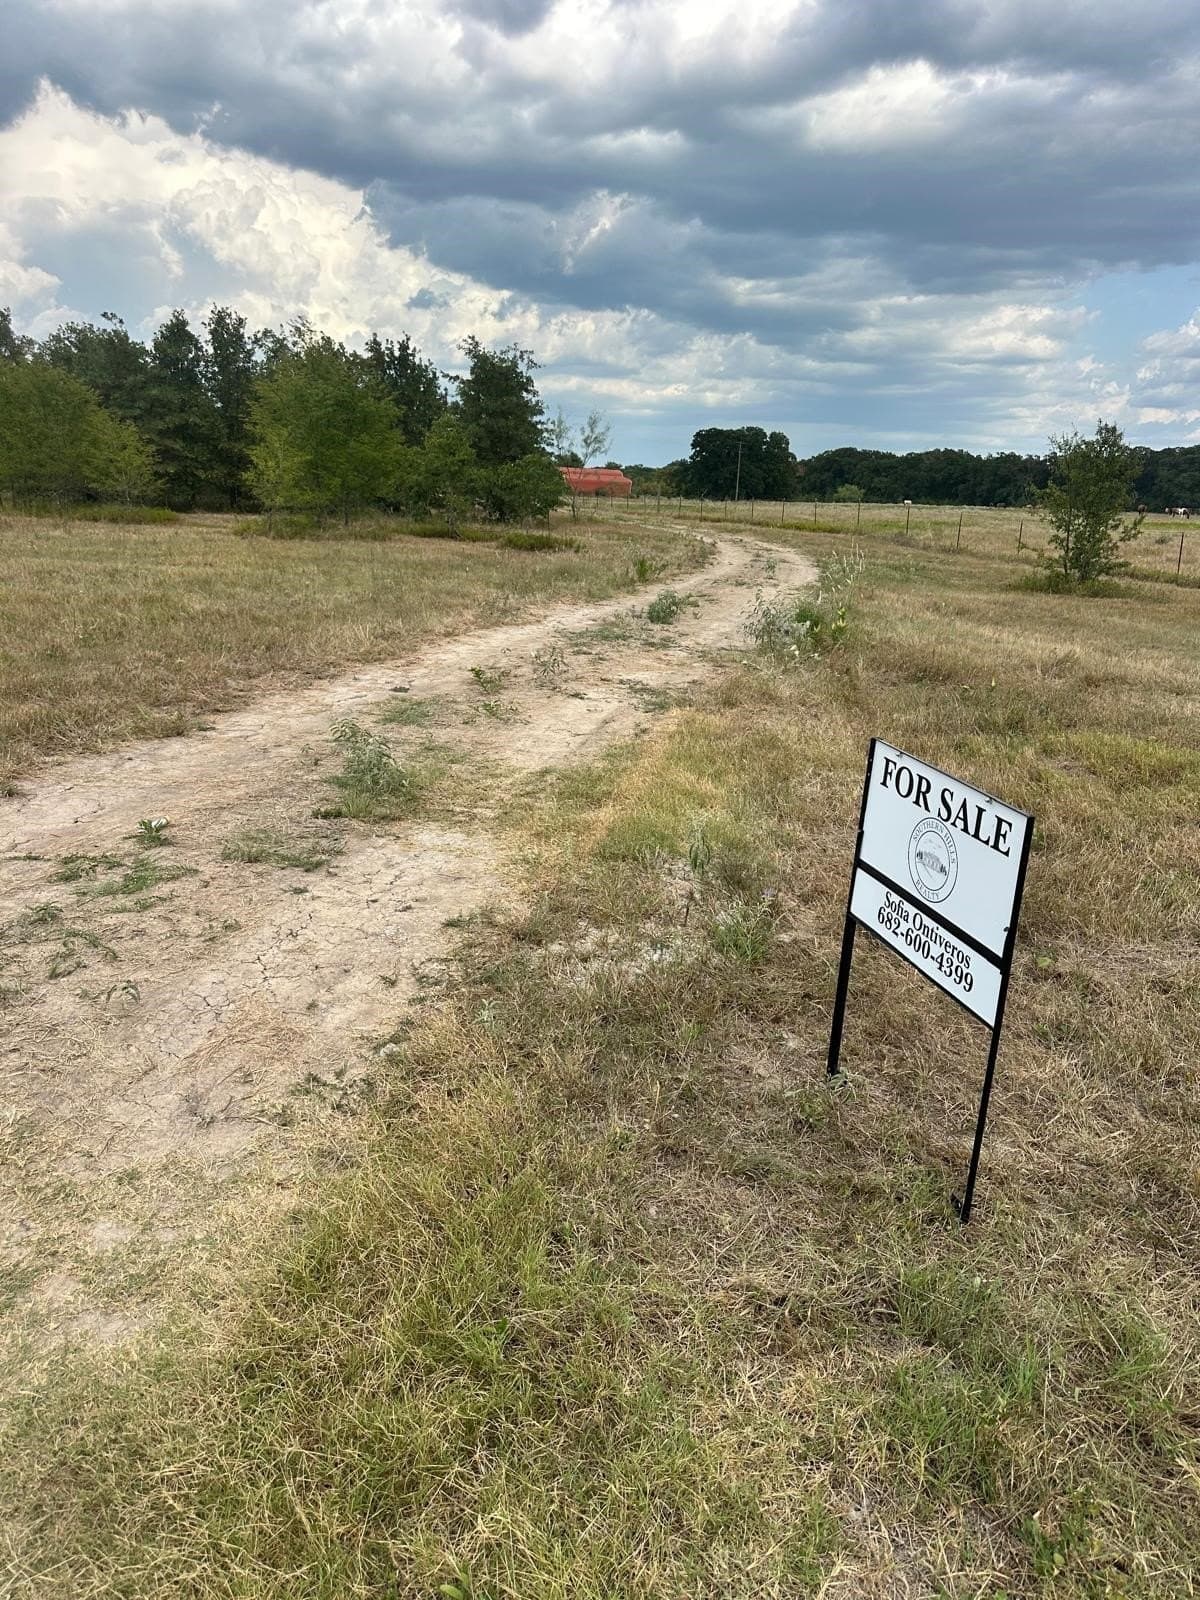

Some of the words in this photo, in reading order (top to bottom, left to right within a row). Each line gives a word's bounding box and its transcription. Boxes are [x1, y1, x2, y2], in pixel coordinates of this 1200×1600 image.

[880, 756, 932, 813] FOR
[938, 787, 1013, 857] SALE
[877, 906, 974, 993] 682-600-4399
[884, 891, 910, 923] Sofia
[912, 912, 971, 969] Ontiveros
